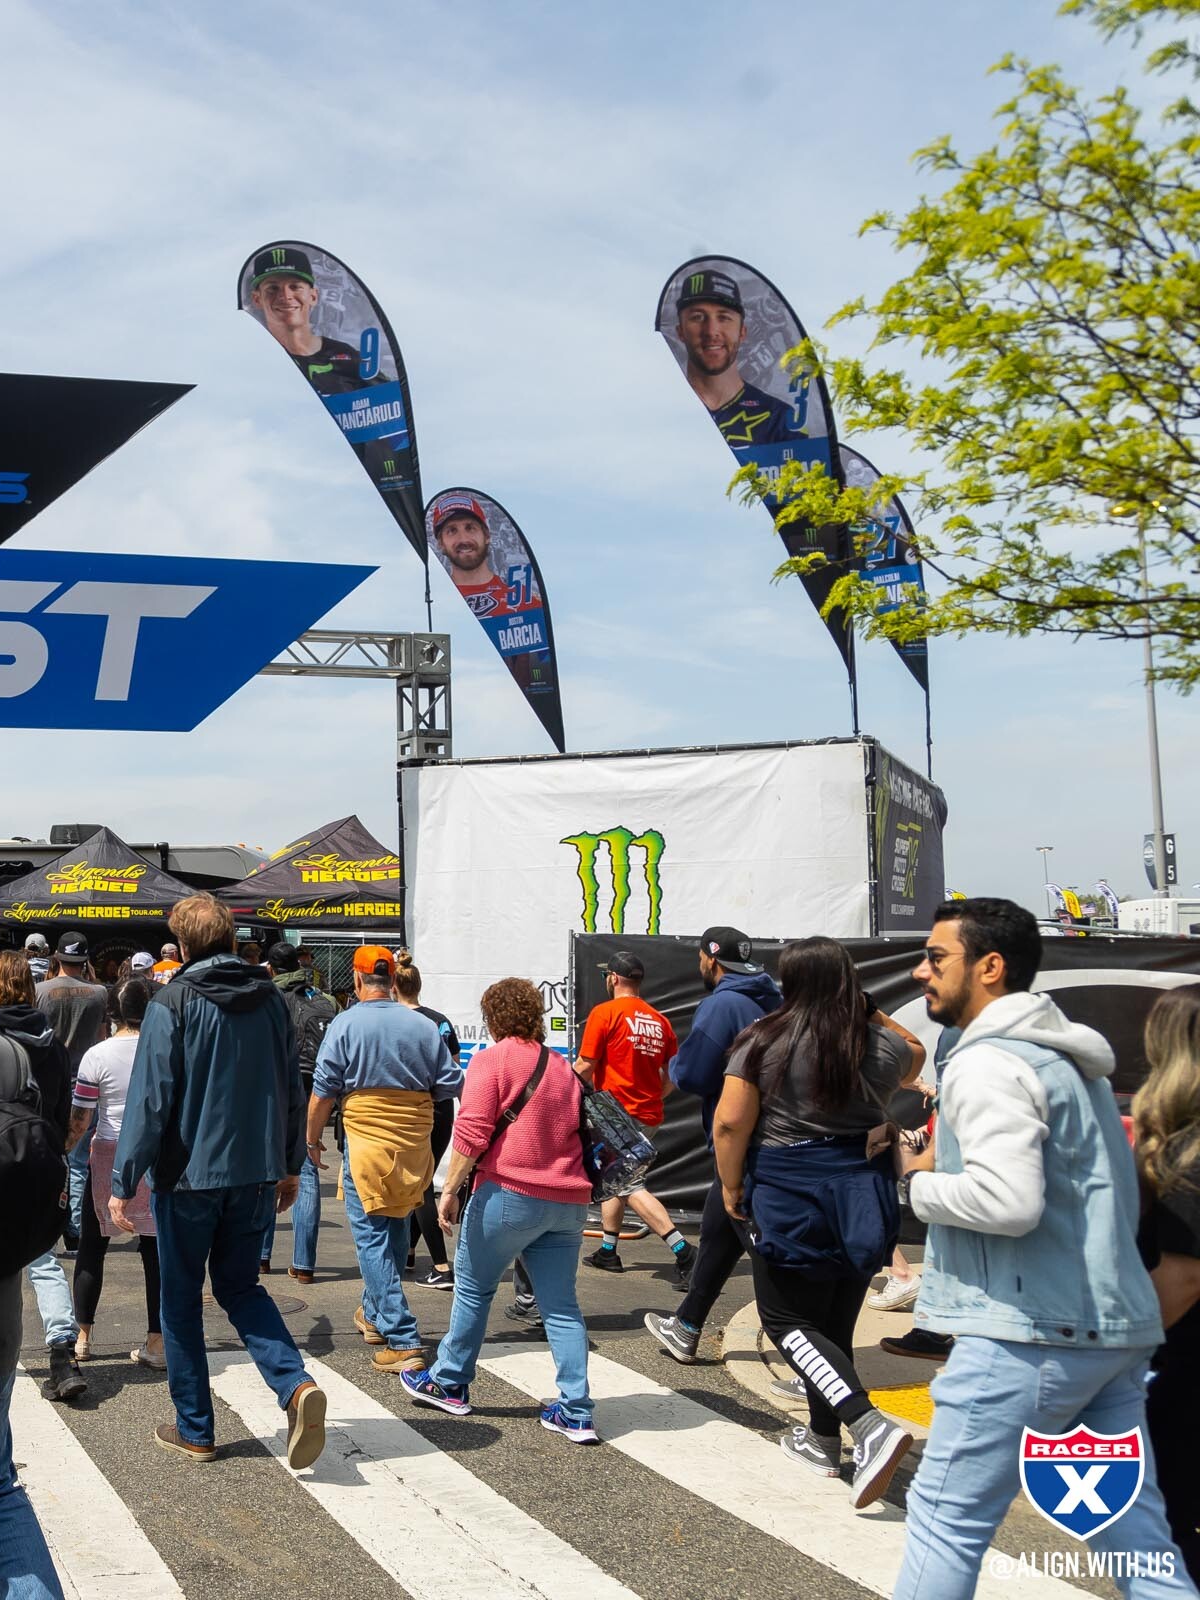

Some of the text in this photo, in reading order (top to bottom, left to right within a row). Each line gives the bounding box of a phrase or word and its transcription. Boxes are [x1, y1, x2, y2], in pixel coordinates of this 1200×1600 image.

[359, 327, 381, 381] 9
[335, 400, 401, 430] IANCIARULO
[352, 397, 371, 411] ADAM
[506, 563, 533, 607] 51
[498, 622, 543, 650] BARCIA
[46, 861, 147, 883] Legends
[1167, 865, 1175, 881] 5
[51, 880, 138, 894] HEROES
[3, 902, 63, 922] Legends
[78, 906, 130, 918] HEROES
[257, 898, 326, 922] Legends
[325, 906, 342, 914] AND
[625, 1016, 663, 1039] VANS
[781, 1329, 853, 1407] PUMA
